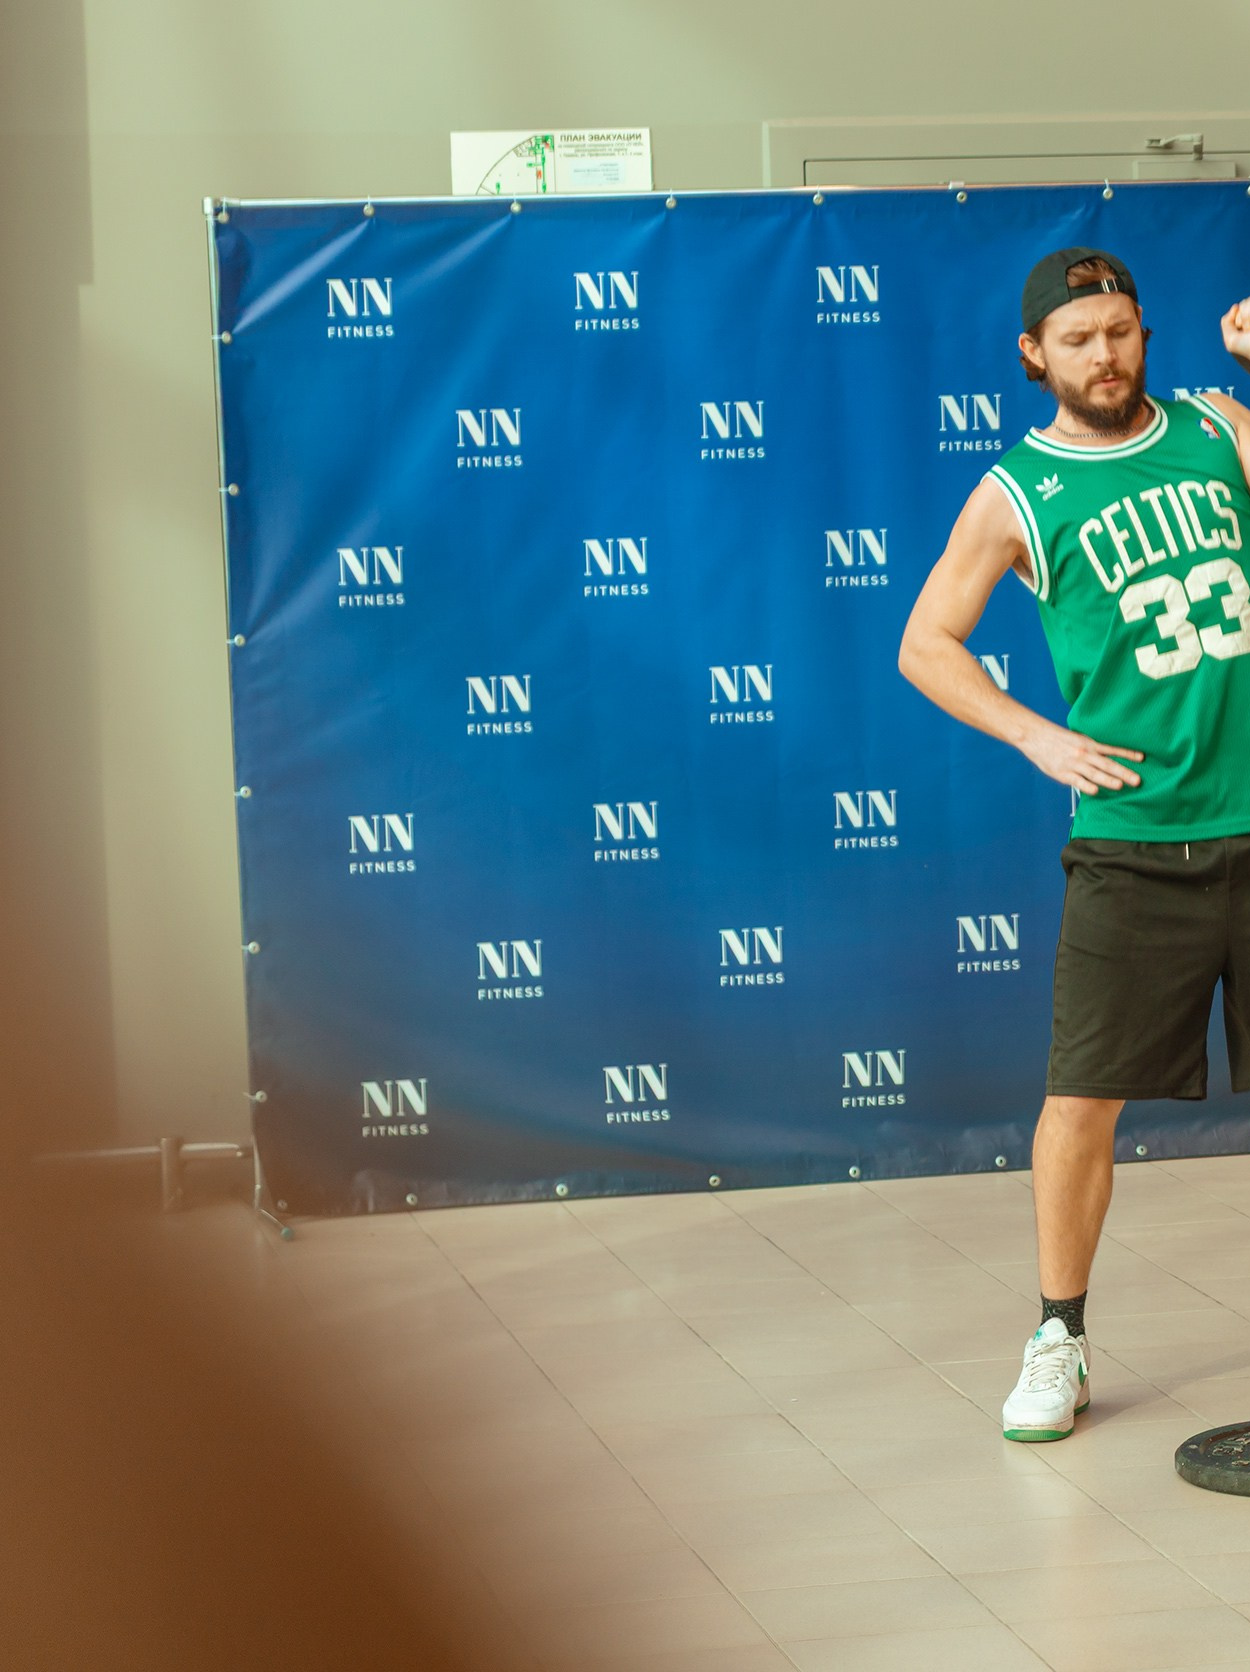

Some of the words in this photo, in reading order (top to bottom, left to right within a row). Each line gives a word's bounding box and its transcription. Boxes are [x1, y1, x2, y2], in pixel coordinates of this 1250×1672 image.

[560, 134, 585, 142] ПЛАН
[588, 133, 642, 142] ЭВАКУАЦИИ
[326, 277, 393, 317] NN
[573, 271, 639, 310] NN
[816, 265, 879, 303] NN
[575, 318, 640, 330] FITNESS
[817, 311, 881, 323] FITNESS
[328, 325, 394, 338] FITNESS
[700, 400, 764, 439] NN
[938, 394, 1001, 432] NN
[456, 408, 521, 447] NN
[701, 447, 766, 460] FITNESS
[940, 440, 1002, 452] FITNESS
[457, 455, 523, 468] FITNESS
[825, 528, 888, 567] NN
[1078, 480, 1243, 594] CELTICS
[337, 546, 403, 586] NN
[583, 537, 648, 576] NN
[584, 583, 649, 597] FITNESS
[826, 575, 889, 587] FITNESS
[339, 593, 405, 607] FITNESS
[465, 674, 531, 714] NN
[709, 664, 773, 703] NN
[467, 721, 533, 735] FITNESS
[710, 710, 774, 724] FITNESS
[593, 801, 658, 841] NN
[833, 789, 896, 829] NN
[348, 813, 413, 853] NN
[834, 836, 899, 849] FITNESS
[350, 860, 416, 874] FITNESS
[594, 848, 660, 862] FITNESS
[719, 926, 783, 966] NN
[956, 913, 1019, 953] NN
[477, 939, 541, 979] NN
[958, 959, 1021, 973] FITNESS
[720, 972, 784, 986] FITNESS
[478, 986, 544, 1000] FITNESS
[842, 1049, 905, 1088] NN
[603, 1063, 667, 1103] NN
[362, 1079, 427, 1118] NN
[842, 1094, 906, 1108] FITNESS
[605, 1110, 670, 1124] FITNESS
[363, 1124, 429, 1137] FITNESS
